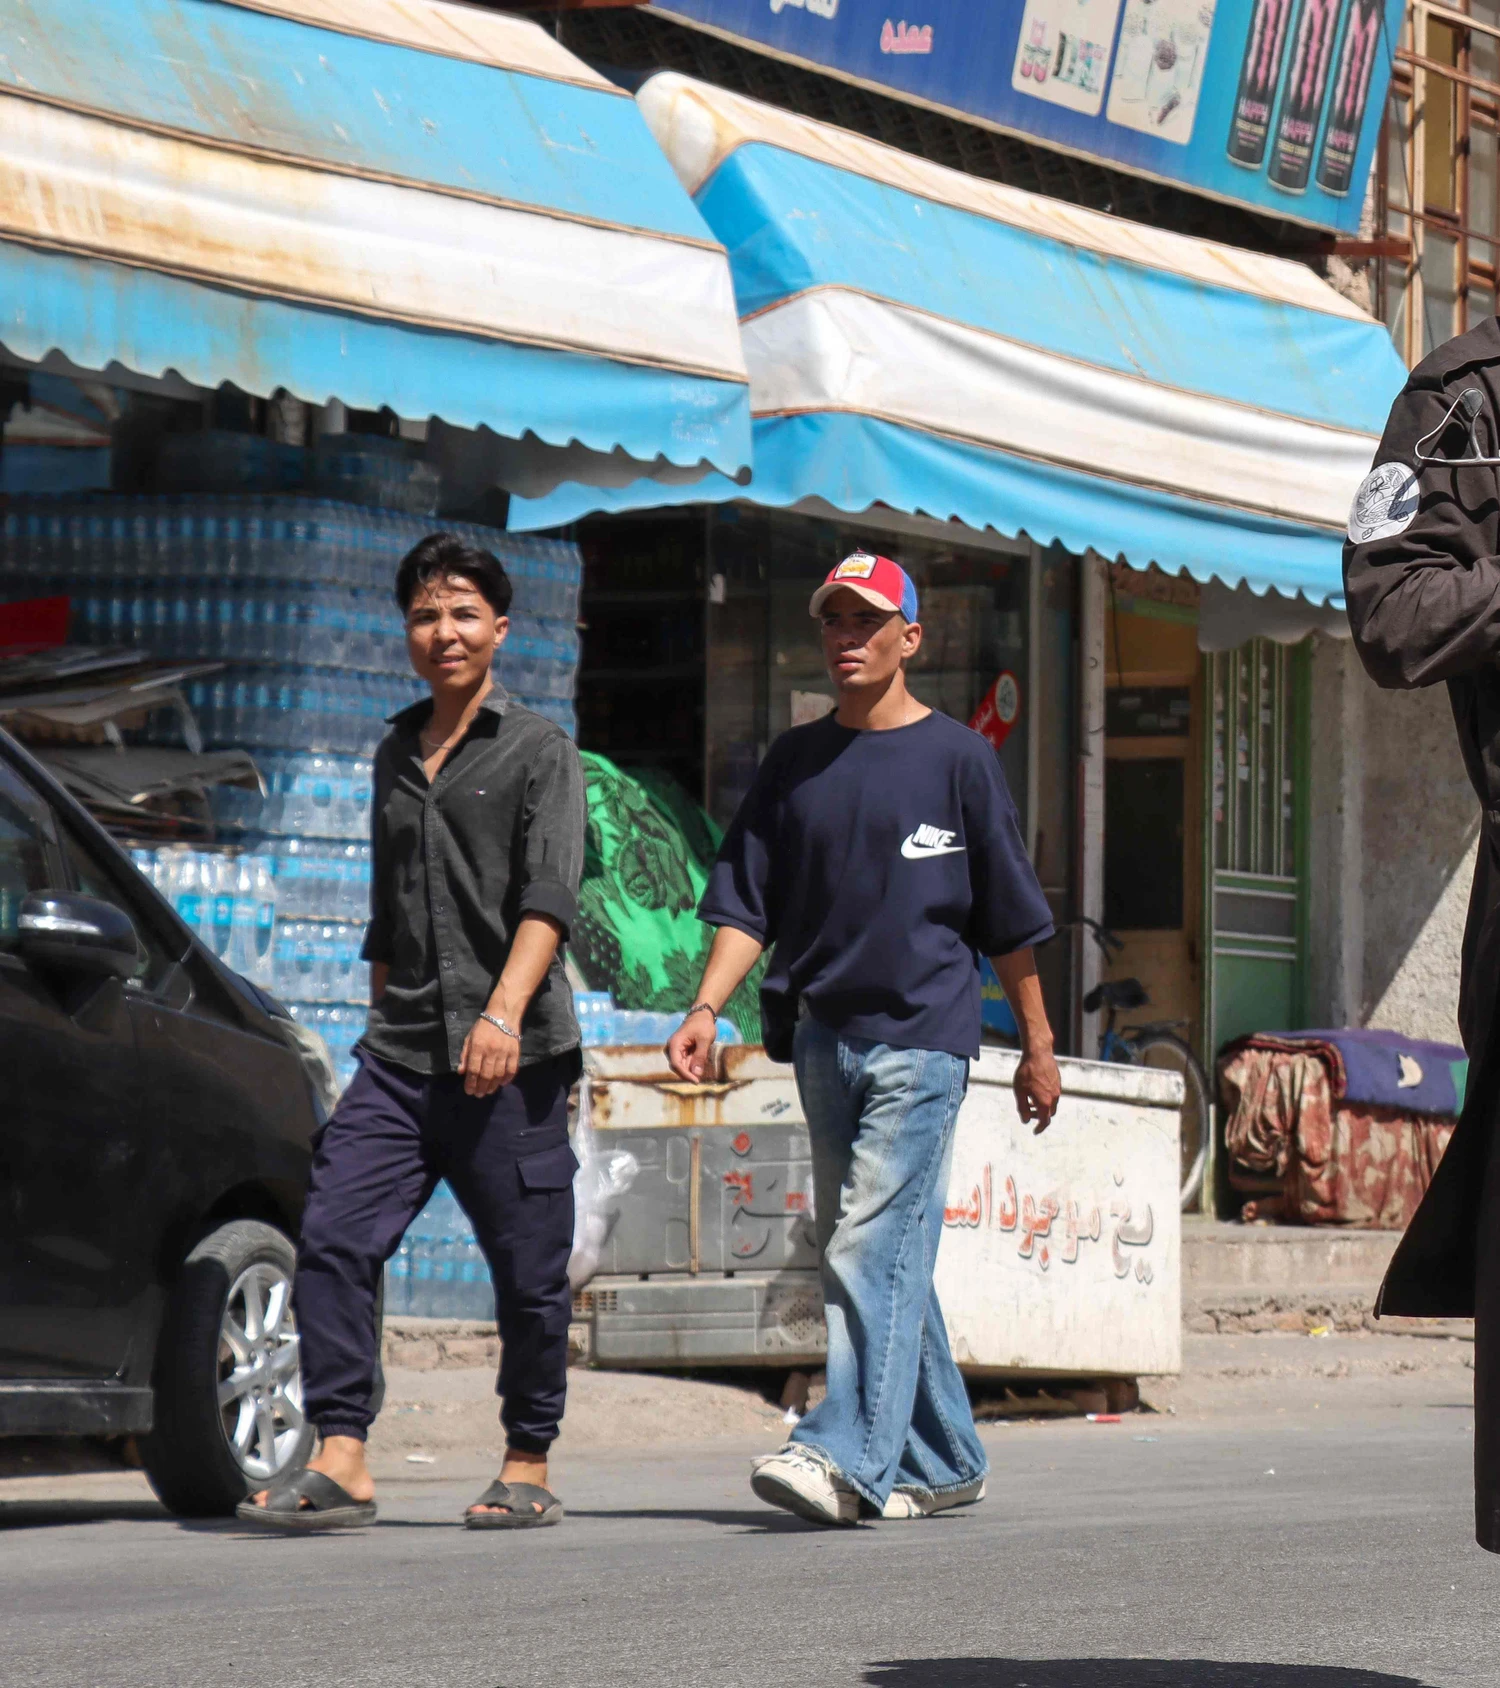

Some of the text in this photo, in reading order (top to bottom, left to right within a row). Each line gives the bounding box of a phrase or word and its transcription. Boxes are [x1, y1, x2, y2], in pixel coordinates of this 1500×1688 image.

[879, 18, 934, 55] عمده
[911, 822, 957, 849] NIKE
[942, 1161, 1154, 1286] یخ موجود اس
